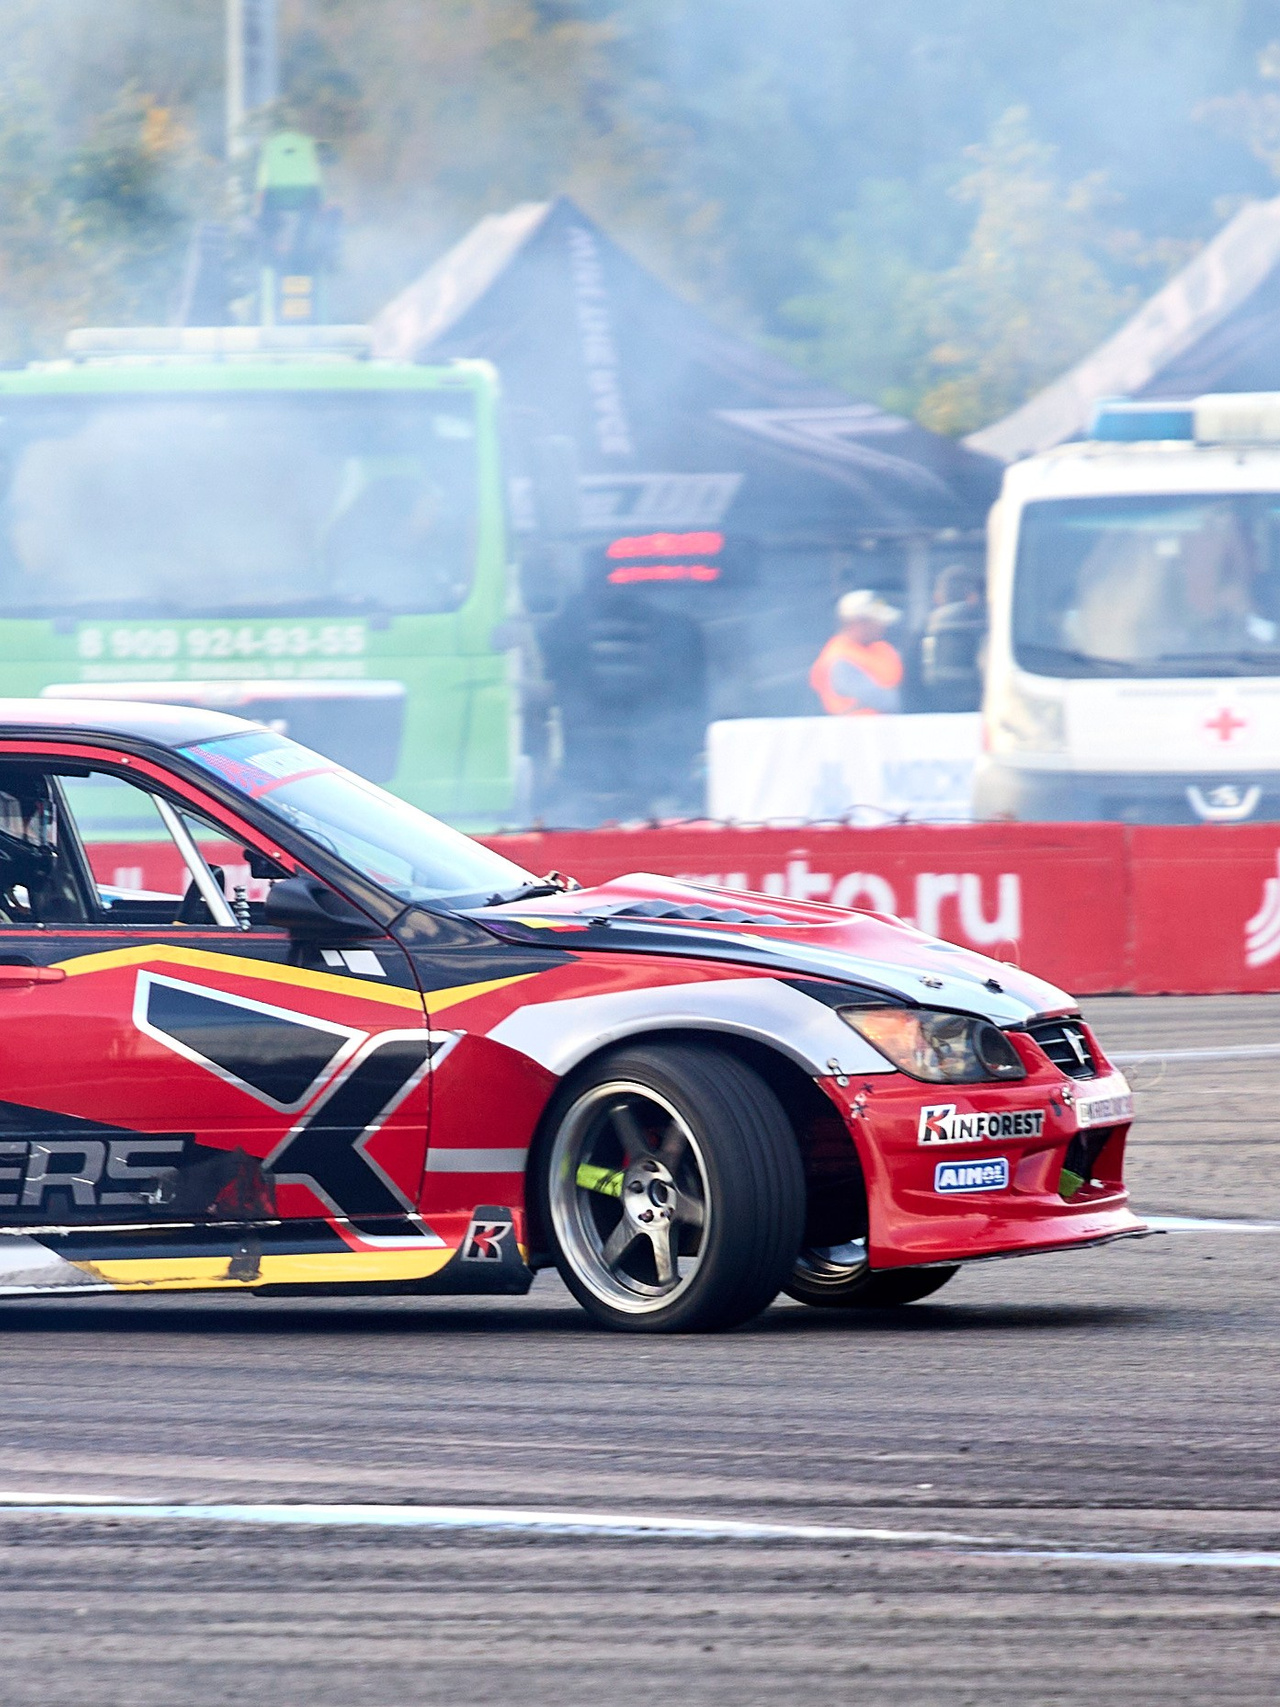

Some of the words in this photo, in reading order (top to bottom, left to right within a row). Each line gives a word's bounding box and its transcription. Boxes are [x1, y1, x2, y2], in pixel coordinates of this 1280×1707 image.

[673, 858, 1021, 944] to.ru
[922, 1108, 1044, 1142] KINFOREST
[939, 1164, 1005, 1187] AIMOL
